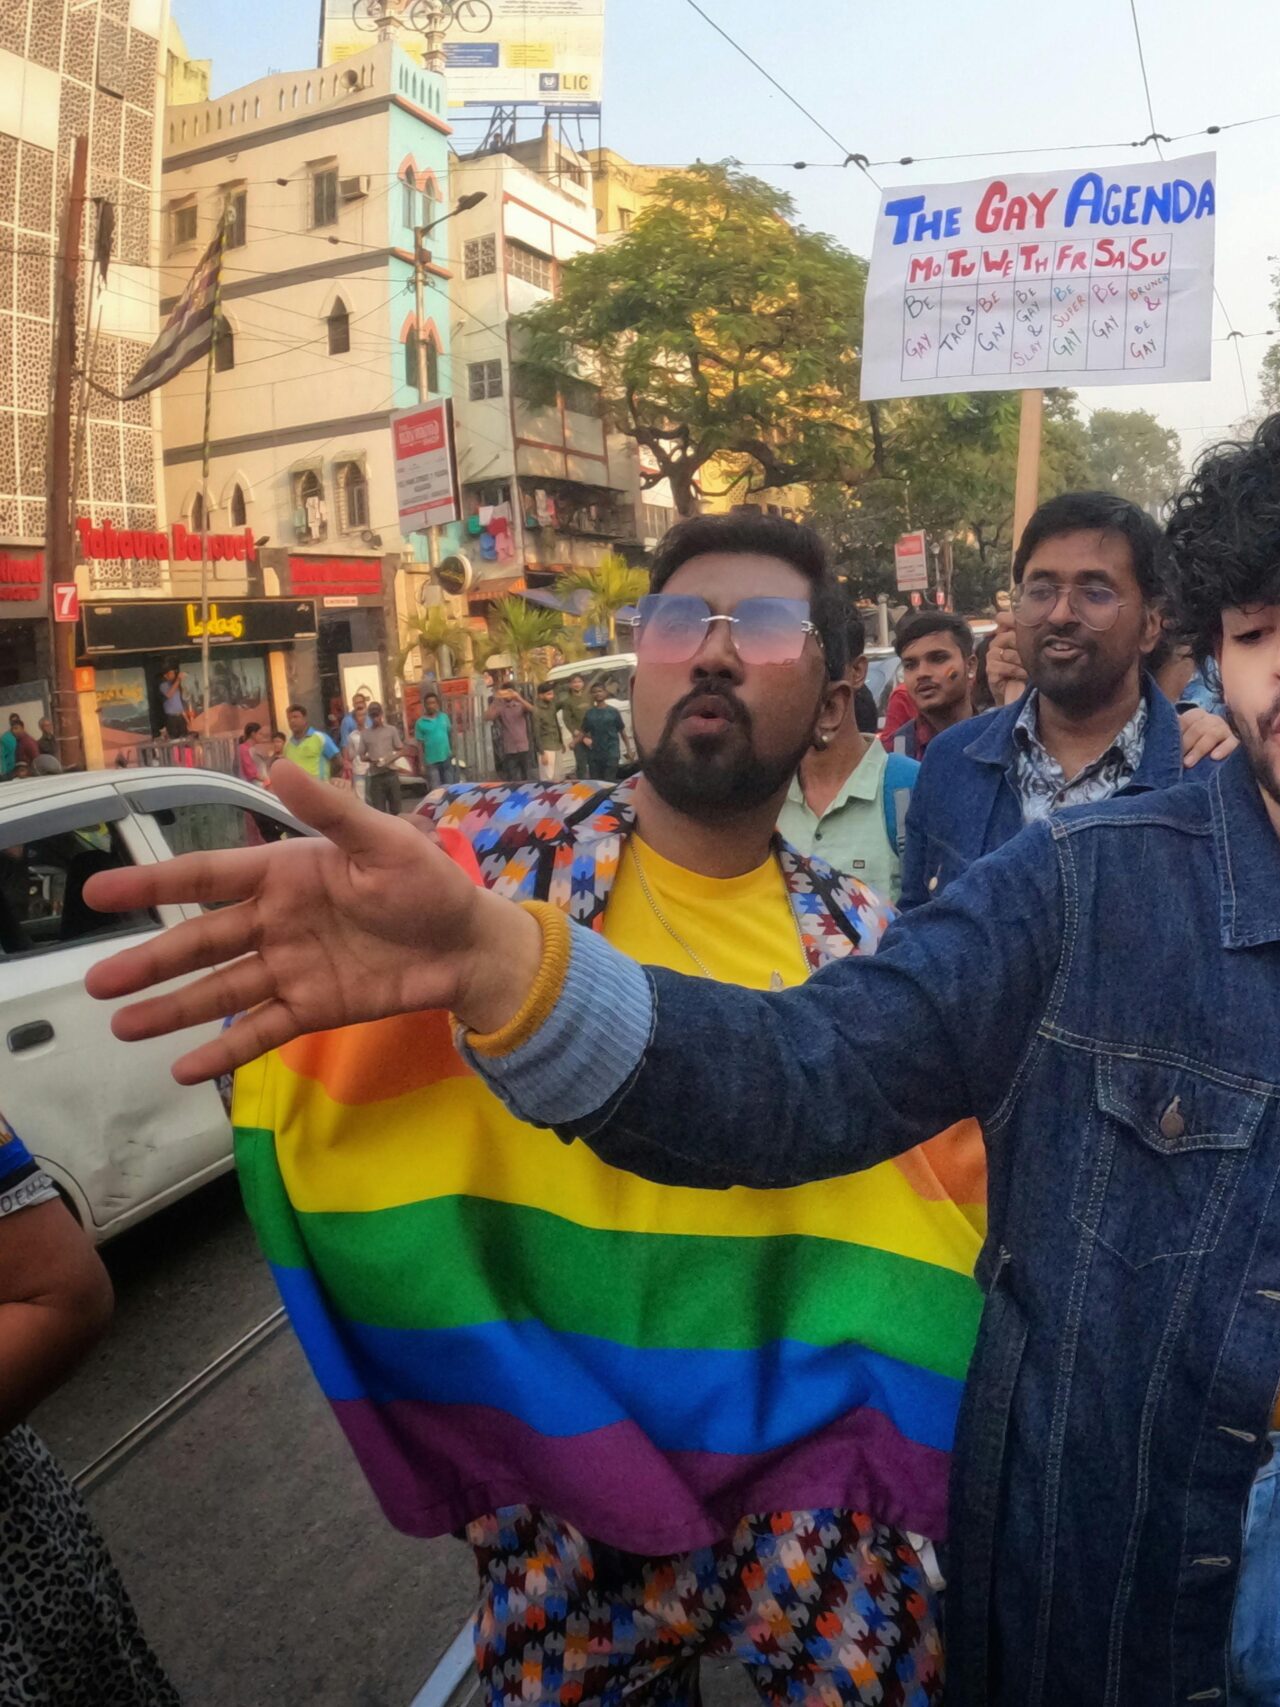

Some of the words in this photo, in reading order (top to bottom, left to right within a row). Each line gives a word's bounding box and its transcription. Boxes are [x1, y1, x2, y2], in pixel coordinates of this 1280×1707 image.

[562, 75, 588, 90] LIC
[885, 195, 962, 245] THE
[975, 181, 1058, 233] GAY
[1064, 172, 1215, 228] AGENDA
[1056, 245, 1087, 272] FR
[979, 290, 1000, 313] BE
[1015, 287, 1036, 304] BE
[1053, 284, 1075, 302] BE
[1092, 281, 1119, 304] BE
[1144, 295, 1161, 311] &
[905, 295, 935, 319] BE
[1016, 301, 1040, 322] GAY
[1052, 294, 1086, 328] SUPER
[940, 305, 975, 351] TACOS
[978, 322, 1005, 351] GAY
[1027, 325, 1043, 337] &
[1092, 315, 1119, 339] GAY
[905, 333, 932, 359] GAY
[1013, 340, 1042, 366] SLAY
[1052, 328, 1082, 356] GAY
[1130, 338, 1157, 360] GAY
[57, 587, 75, 615] 7
